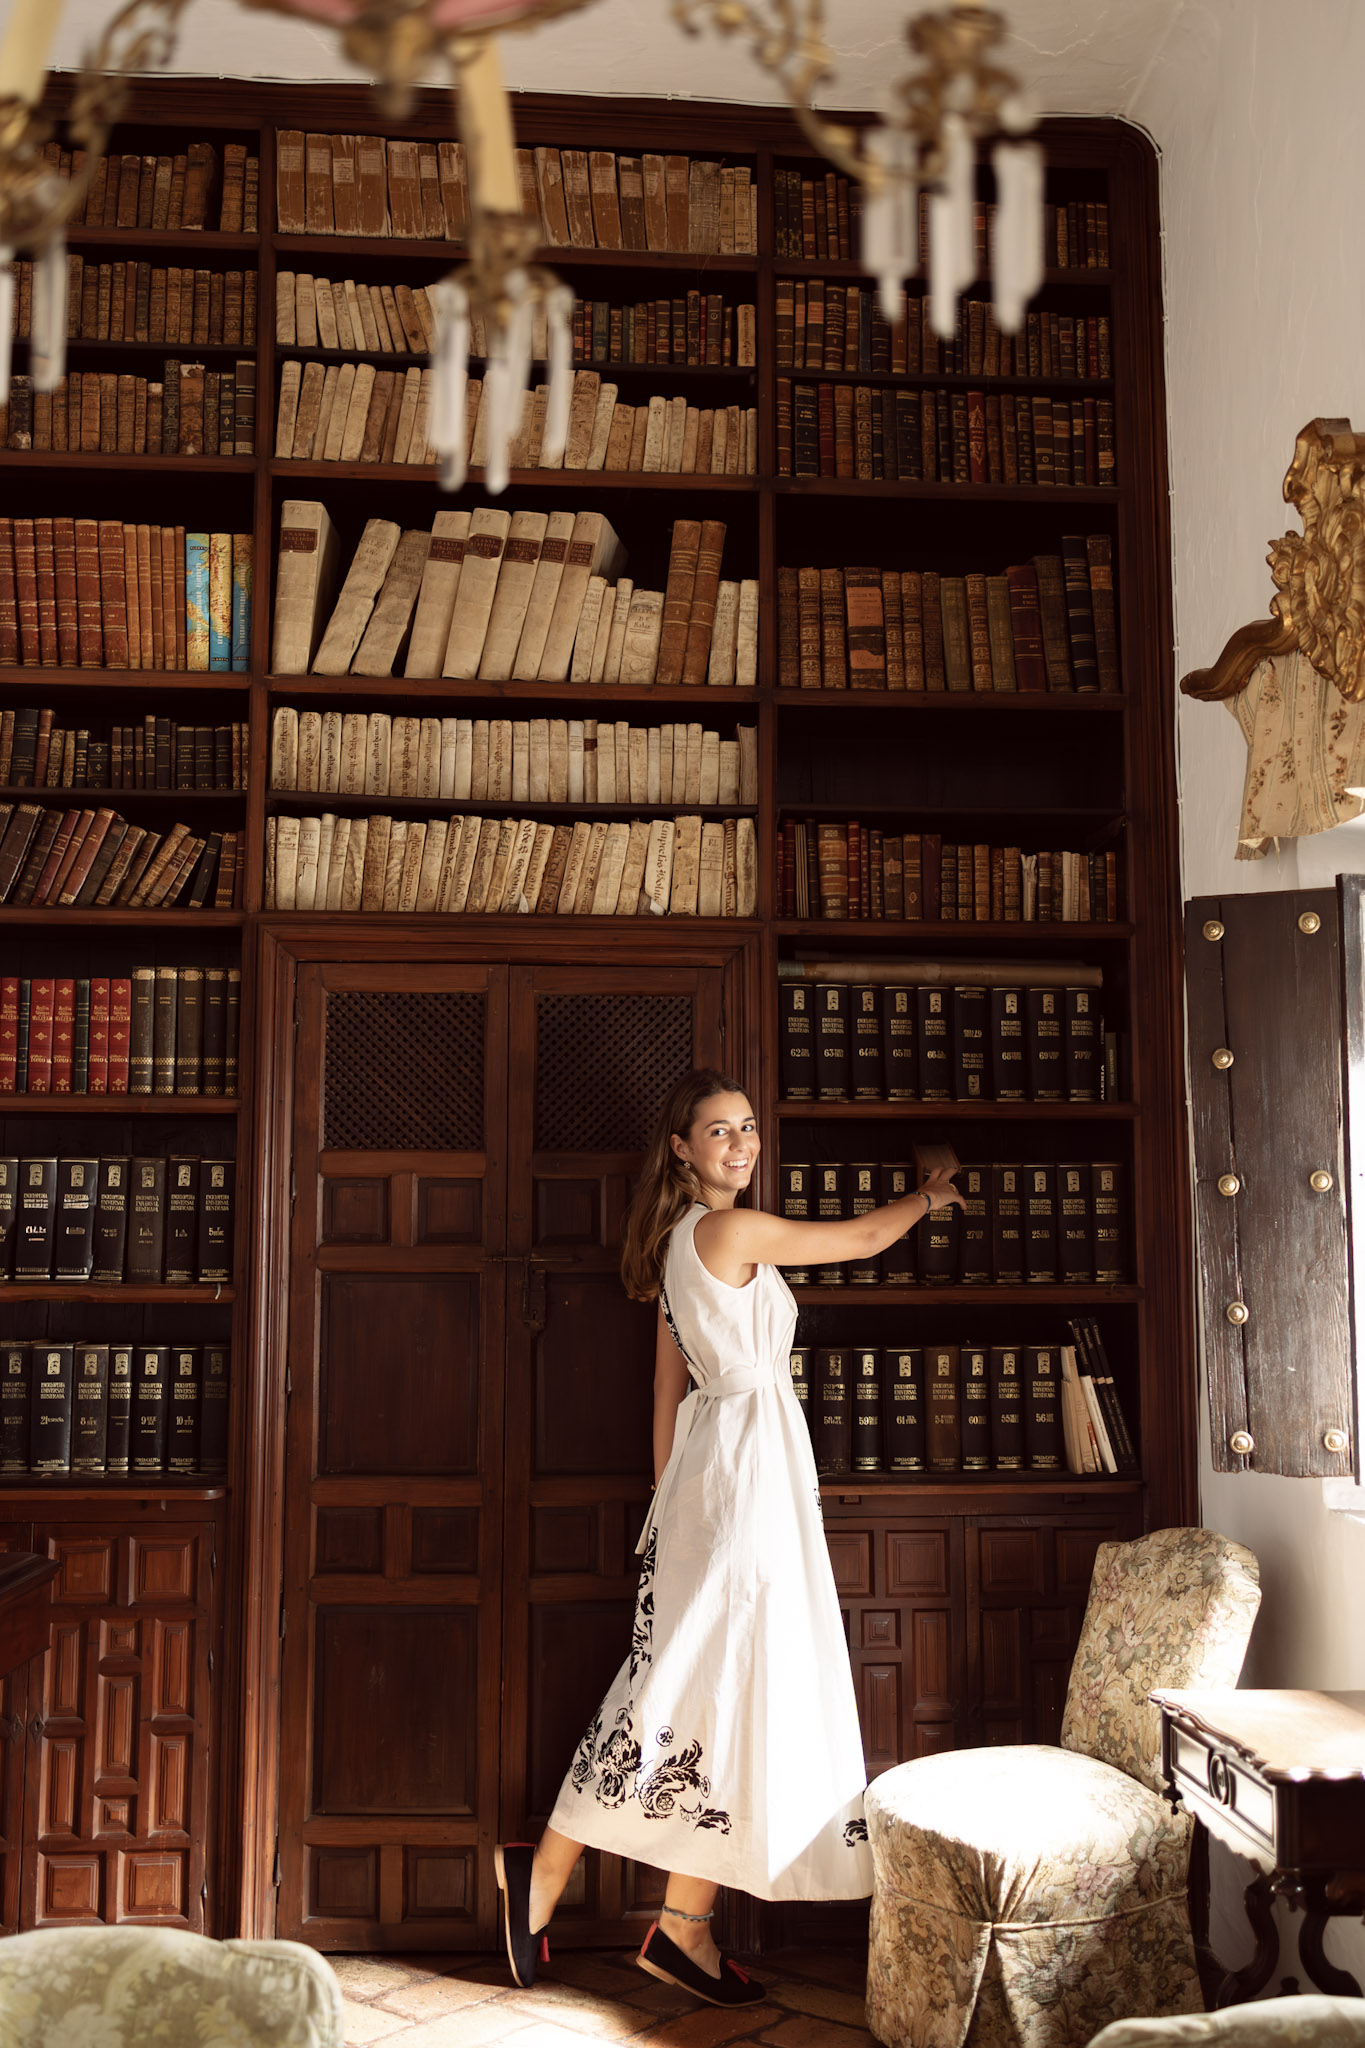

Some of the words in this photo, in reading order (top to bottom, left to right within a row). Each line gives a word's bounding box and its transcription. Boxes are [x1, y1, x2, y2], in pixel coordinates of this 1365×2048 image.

[790, 1048, 801, 1057] 62
[824, 1049, 834, 1057] 63
[892, 1049, 903, 1058] 65
[40, 1416, 48, 1425] 21
[80, 1417, 86, 1425] 8
[141, 1416, 146, 1425] 9
[176, 1416, 183, 1425] 10
[859, 1416, 869, 1425] 59
[896, 1416, 906, 1424] 61
[968, 1416, 979, 1424] 60
[1000, 1414, 1010, 1424] 55
[1036, 1413, 1046, 1423] 56
